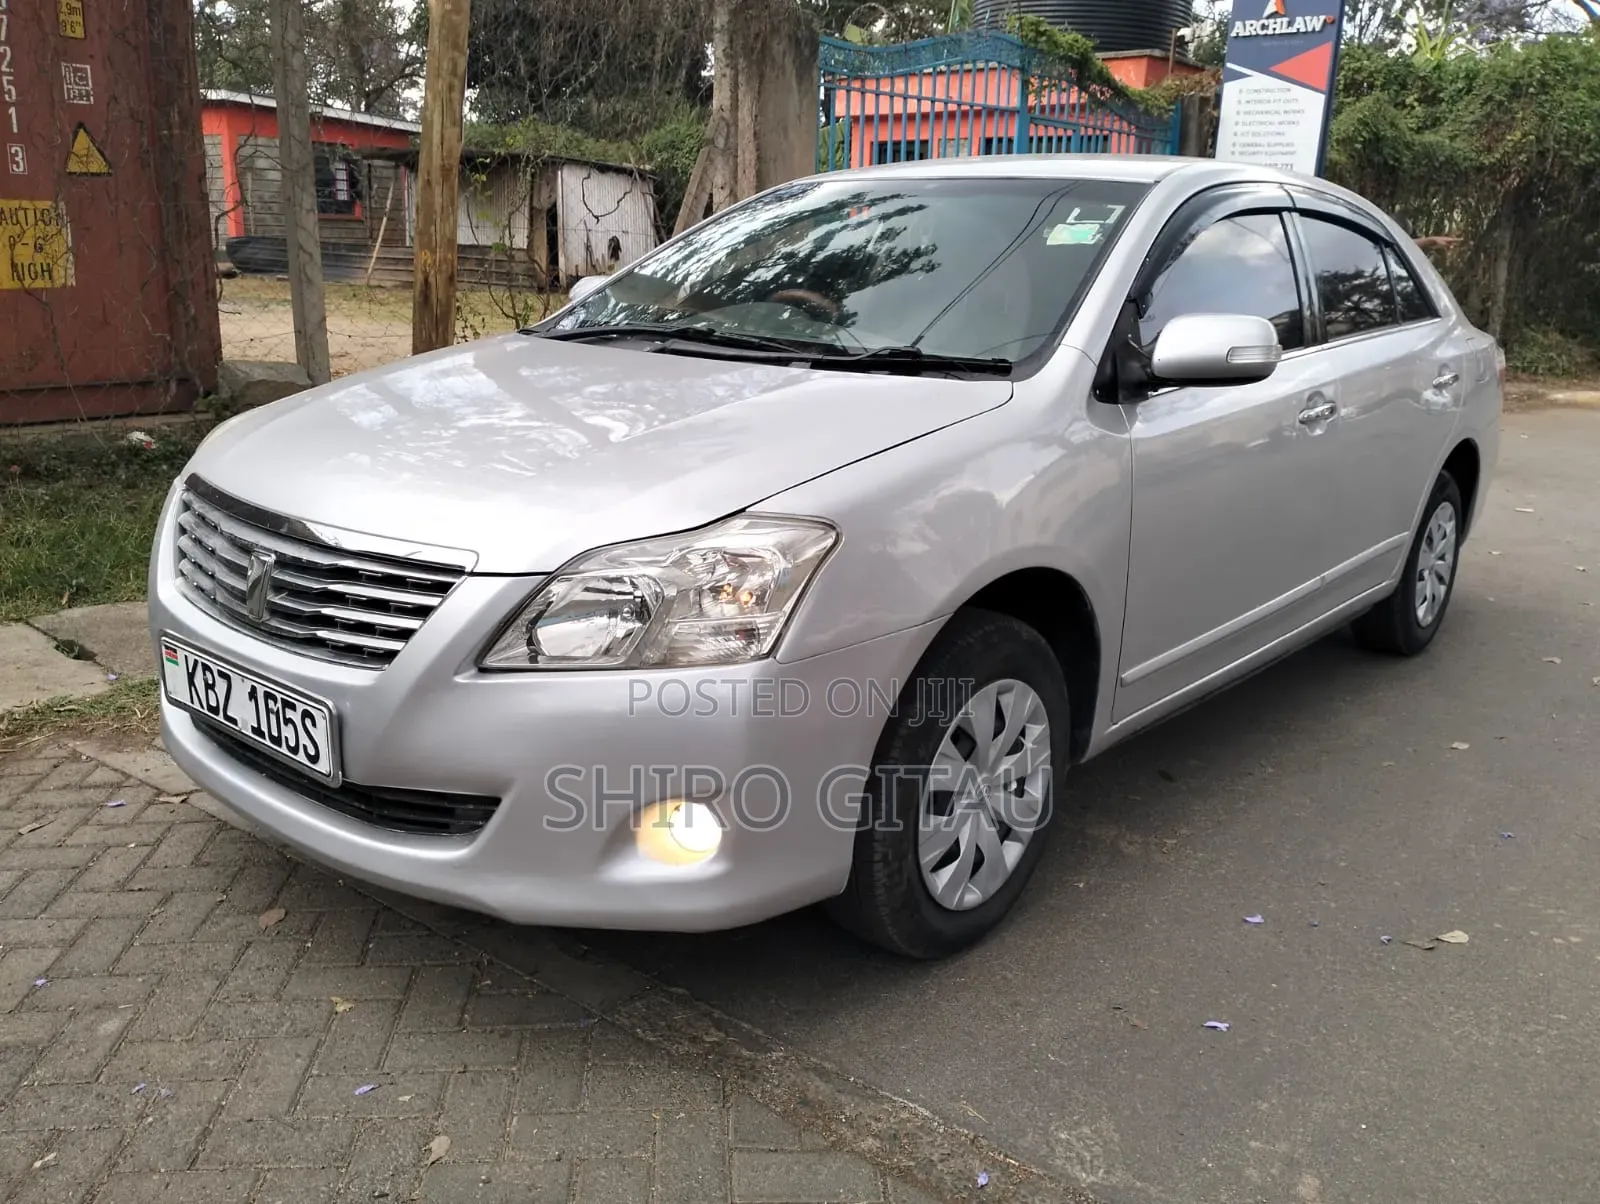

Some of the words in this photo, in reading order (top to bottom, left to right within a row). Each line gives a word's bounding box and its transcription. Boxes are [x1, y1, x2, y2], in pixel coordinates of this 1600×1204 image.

[1230, 15, 1327, 37] ARCHLAW
[11, 146, 24, 172] 3
[184, 654, 239, 727] KBZ
